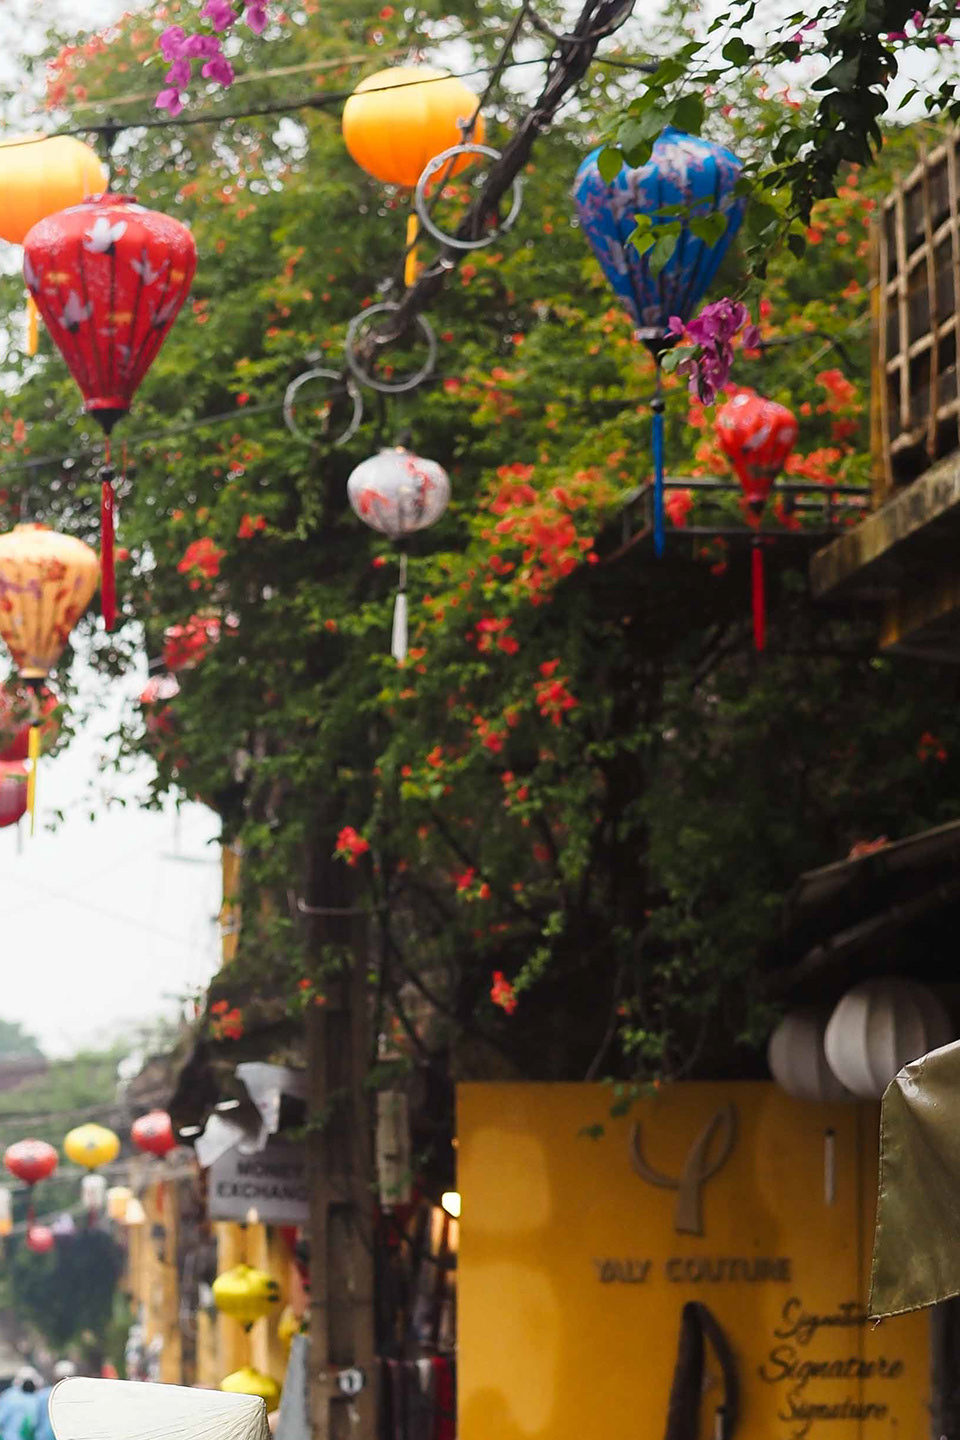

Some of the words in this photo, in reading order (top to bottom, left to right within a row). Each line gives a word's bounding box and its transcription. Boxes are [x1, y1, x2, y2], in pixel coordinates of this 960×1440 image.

[665, 1257, 792, 1284] COUTURE
[758, 1345, 905, 1396] Signature
[778, 1391, 888, 1436] Signature
